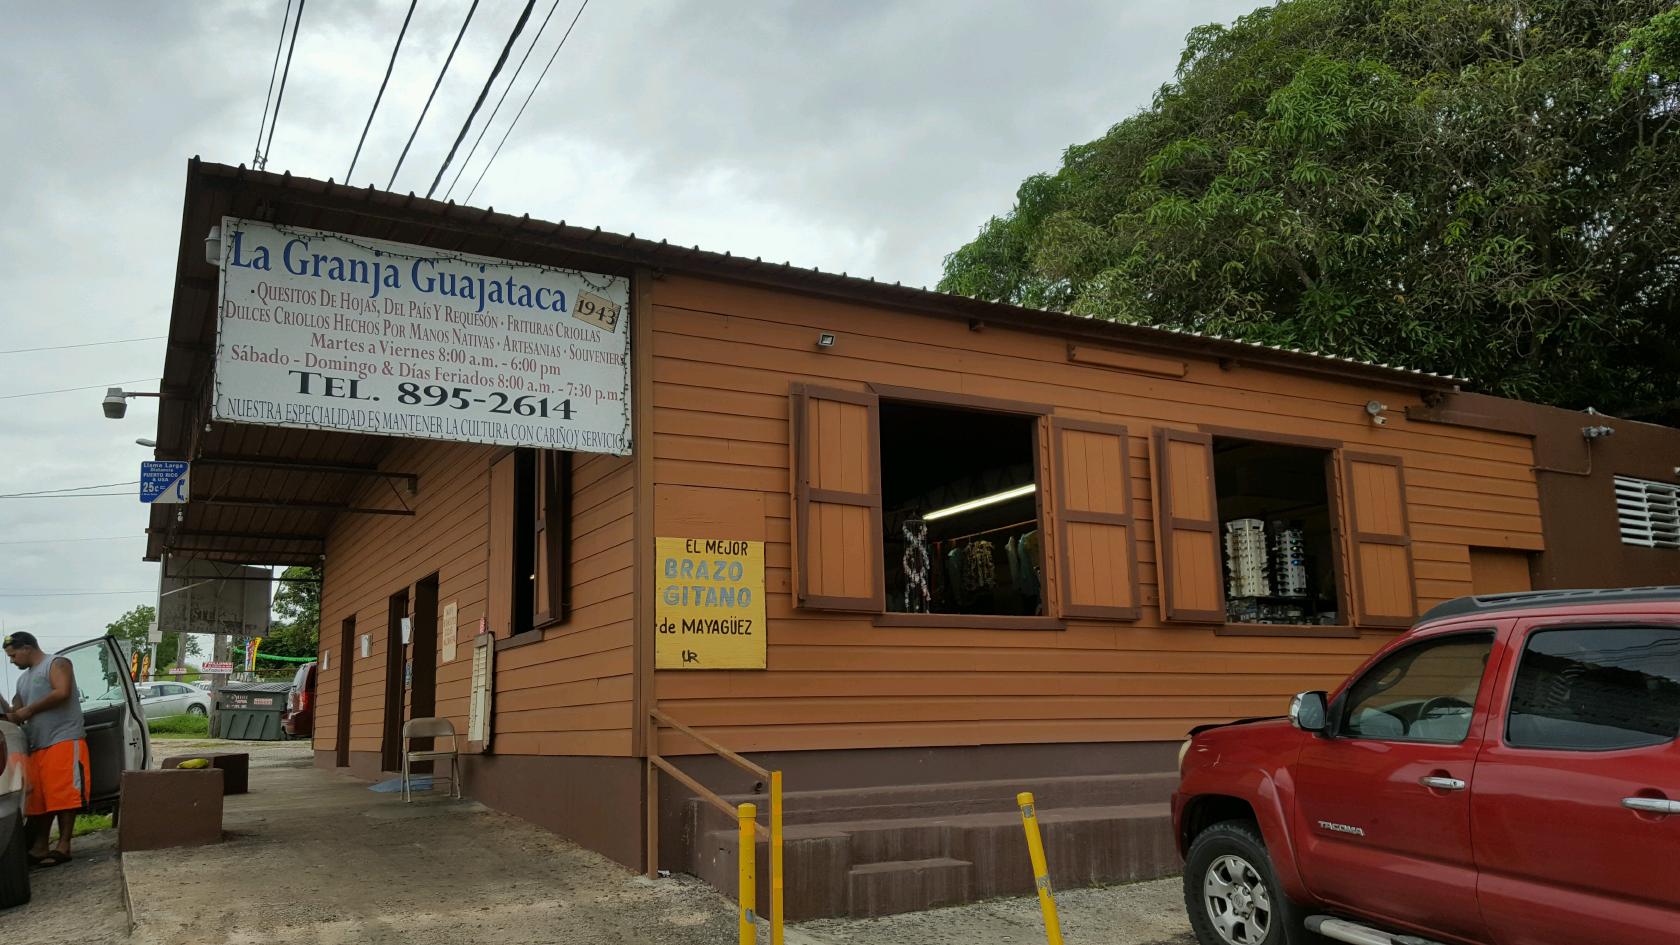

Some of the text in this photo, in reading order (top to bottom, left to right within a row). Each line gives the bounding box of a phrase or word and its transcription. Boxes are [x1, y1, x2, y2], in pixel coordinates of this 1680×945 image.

[231, 231, 567, 313] La Granja Guajataca
[225, 301, 624, 367] DULCES CRIOLLOS HECHOS POR MANOS NATIVAS ARTESANIAS SOUVENIERS
[257, 282, 316, 305] QUESITOS
[320, 289, 336, 308] DE
[340, 291, 381, 317] HOJAS,
[384, 297, 405, 317] DEL
[433, 304, 441, 320] Y
[507, 315, 553, 337] FRITURAS
[556, 322, 600, 343] CRIOLLAS
[577, 299, 616, 325] 1943
[231, 344, 290, 365] Sábado
[305, 352, 377, 379] Domingo
[381, 361, 394, 376] &
[399, 362, 431, 380] Días
[435, 366, 494, 387] Feriados
[497, 373, 524, 391] 8:00
[527, 381, 555, 394] a.m.
[567, 382, 592, 398] 7:30
[310, 332, 364, 352] Martes
[368, 343, 376, 354] a
[379, 339, 434, 361] Viernes
[439, 347, 465, 364] 8:00
[469, 355, 498, 369] a.m.
[511, 356, 536, 373] 6:00
[540, 363, 560, 379] pm
[288, 370, 578, 421] TEL. 895-2614
[227, 397, 282, 420] NUESTRA
[286, 403, 366, 427] ESPECIALIDAD
[368, 410, 380, 429] ES
[383, 412, 443, 433] MANTENER
[446, 417, 459, 436] LA
[461, 418, 508, 439] CULTURA
[511, 423, 534, 443] CON
[582, 432, 624, 450] SERVICIO
[664, 557, 744, 582] BRAZO
[686, 539, 748, 556] EL MEJOR
[663, 585, 752, 608] GITANO
[659, 616, 752, 635] de MAYAGÜEZ
[1317, 820, 1366, 837] TACOMA
